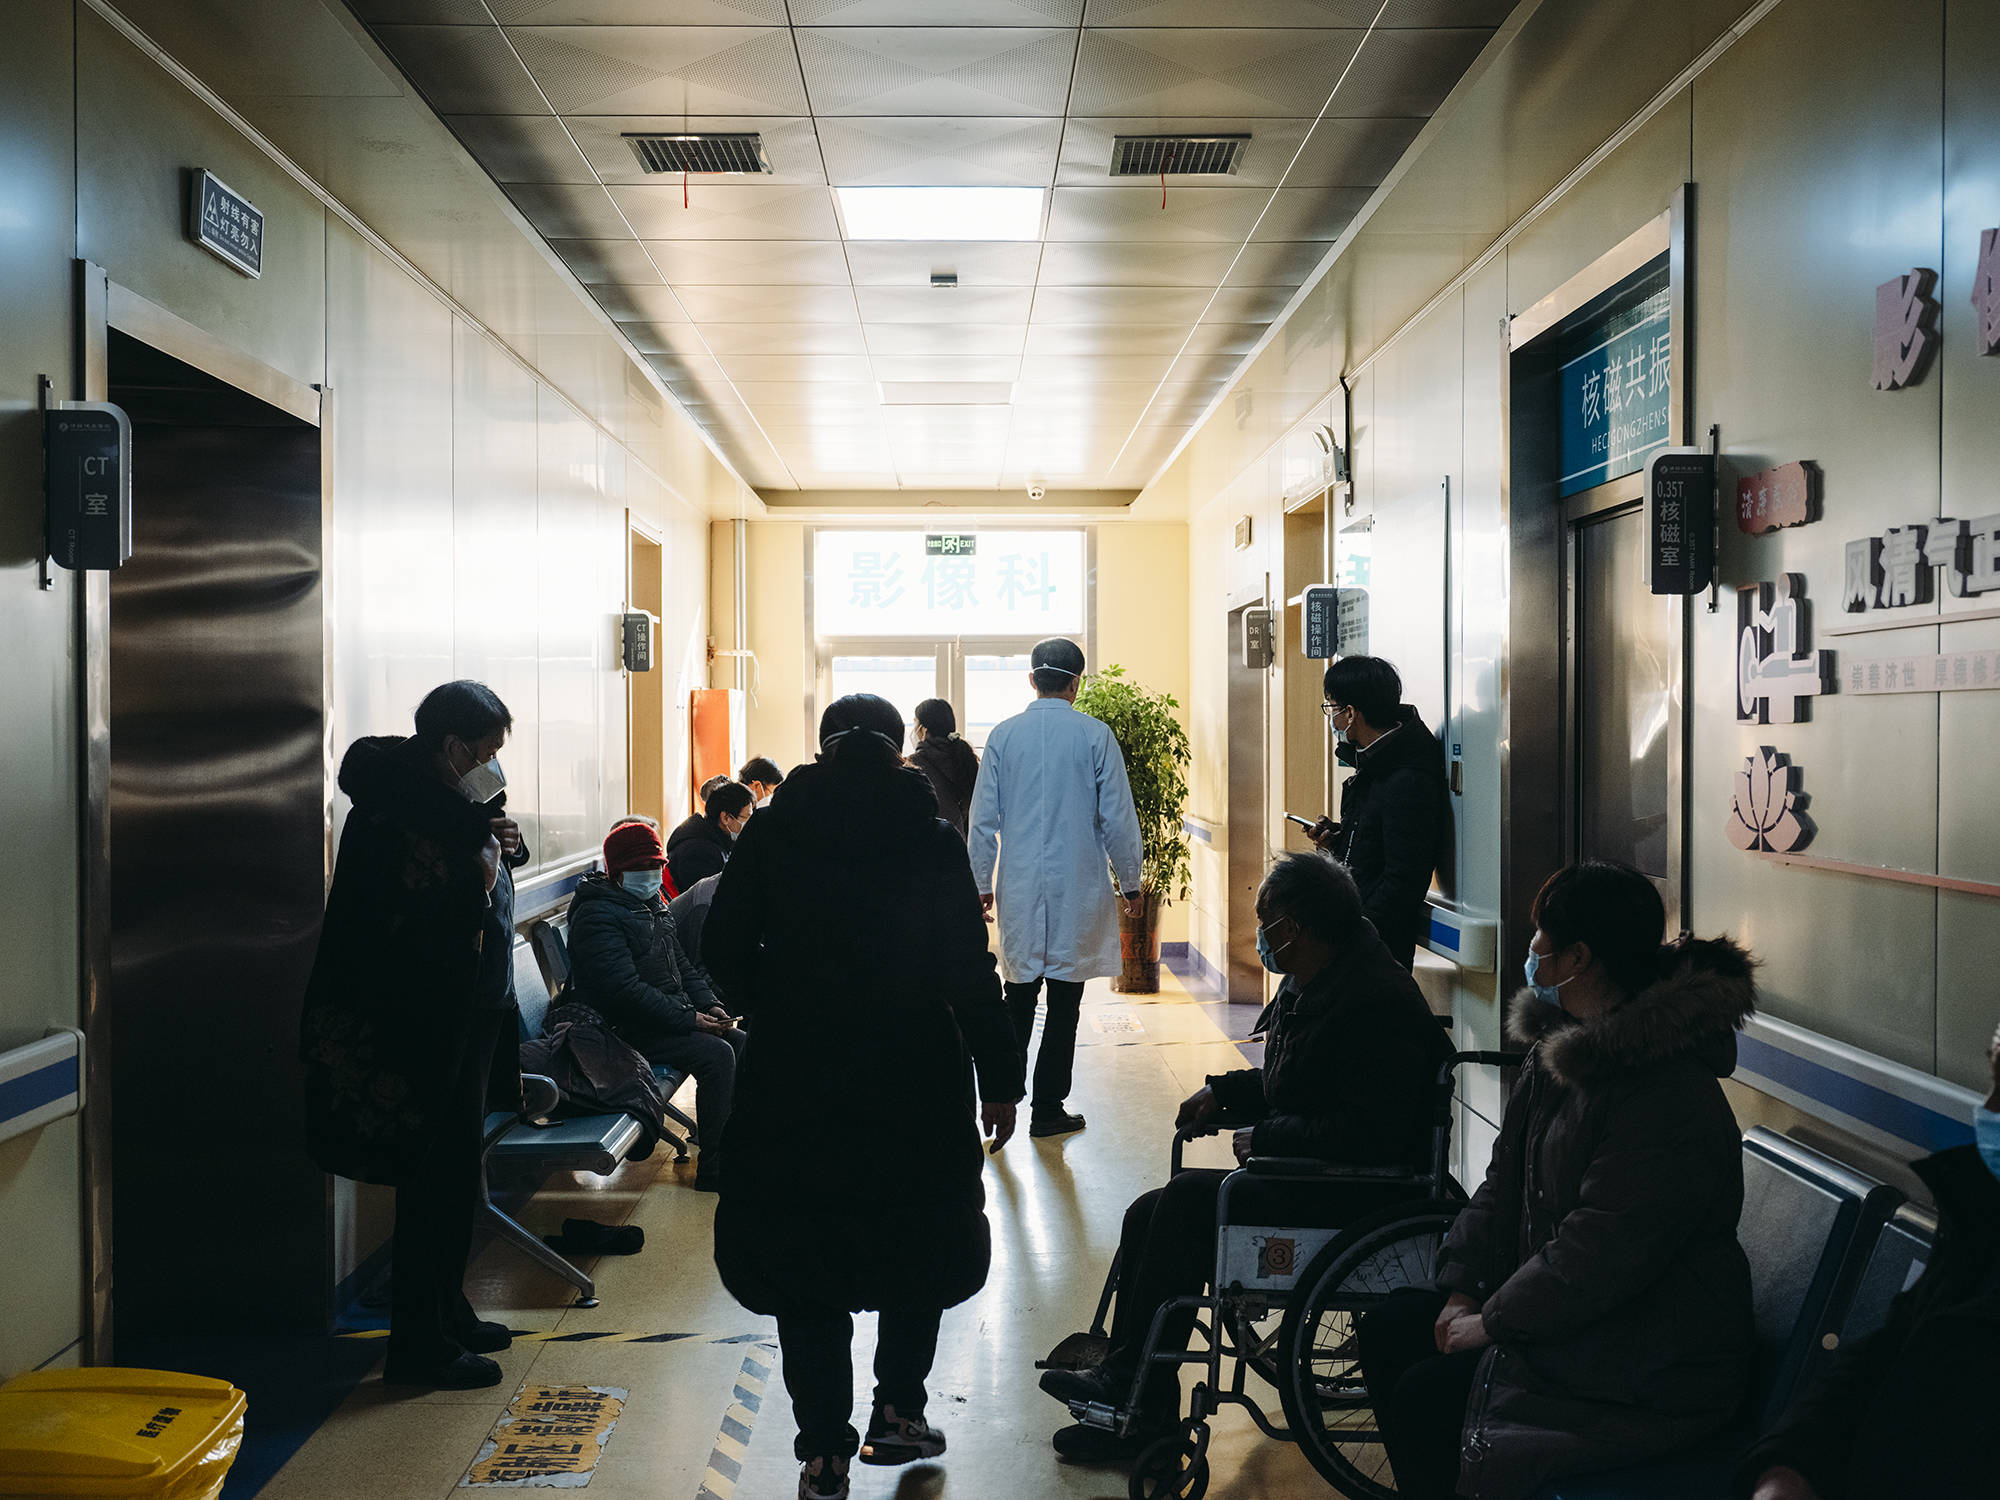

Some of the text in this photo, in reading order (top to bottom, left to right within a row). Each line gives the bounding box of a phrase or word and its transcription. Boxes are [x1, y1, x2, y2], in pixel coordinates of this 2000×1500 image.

[219, 216, 259, 256] 灯亮勿入
[220, 196, 260, 237] 射线有害
[1582, 331, 1671, 429] 核磁共振
[1592, 406, 1671, 454] HECIGONGZHENS
[960, 539, 974, 547] EXIT
[848, 550, 1056, 611] 影像科
[1311, 601, 1321, 657] 核磁操作间
[1852, 655, 2000, 690] 崇善济世 厚德修
